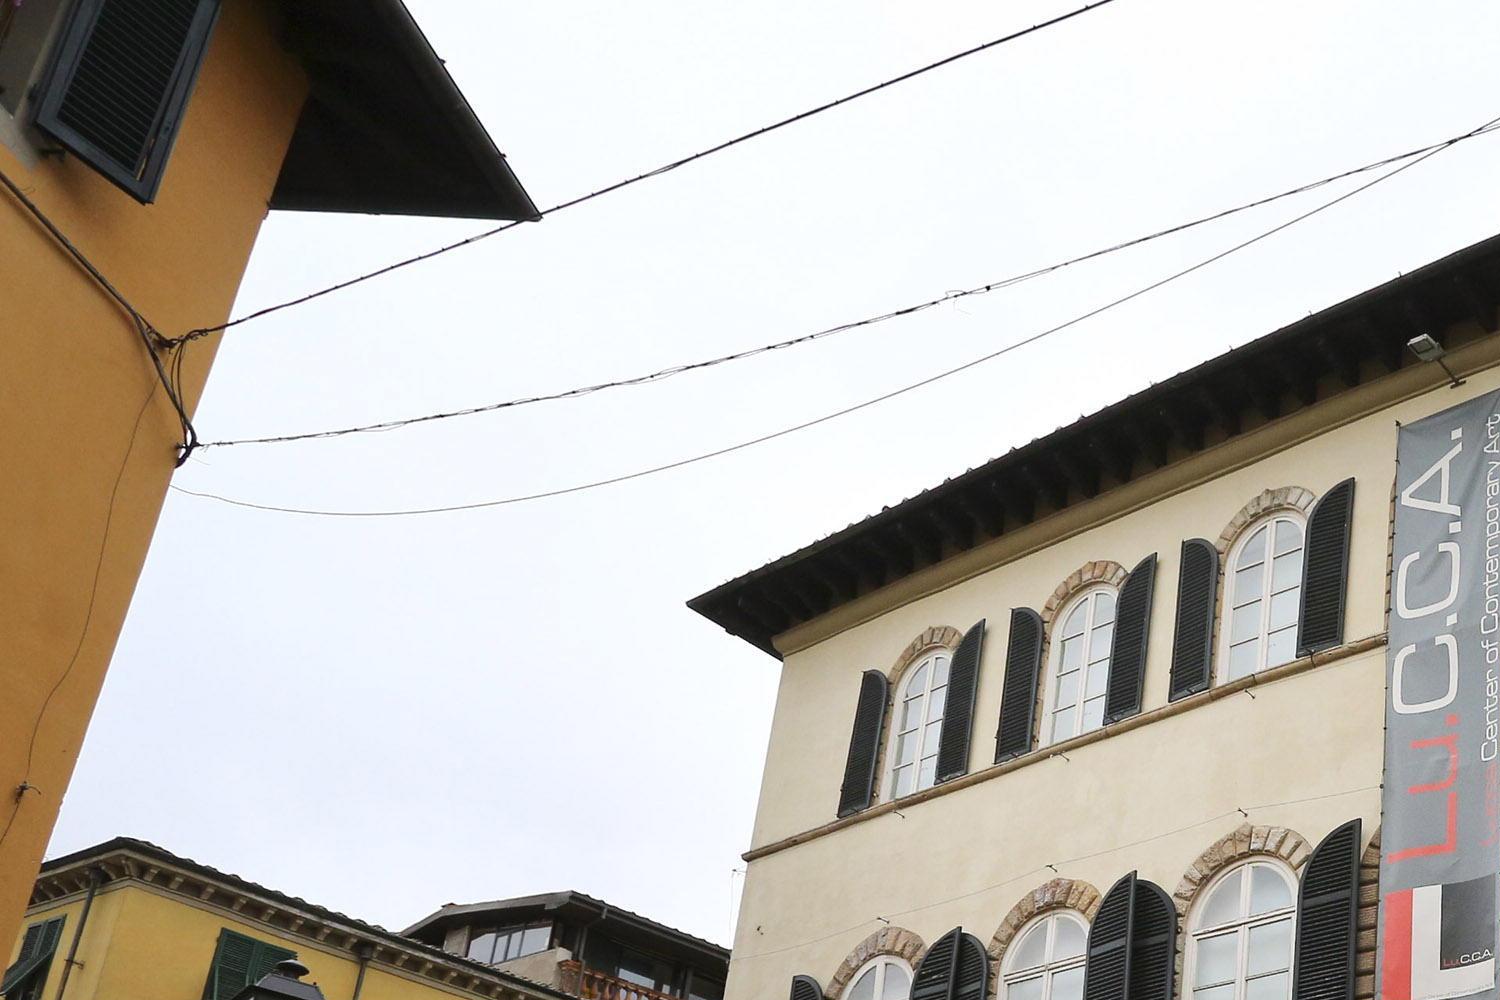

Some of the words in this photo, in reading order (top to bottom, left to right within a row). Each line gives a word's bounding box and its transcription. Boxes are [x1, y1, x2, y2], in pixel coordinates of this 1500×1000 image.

[1484, 413, 1500, 454] Art
[1481, 640, 1499, 664] of
[1480, 670, 1499, 762] Center
